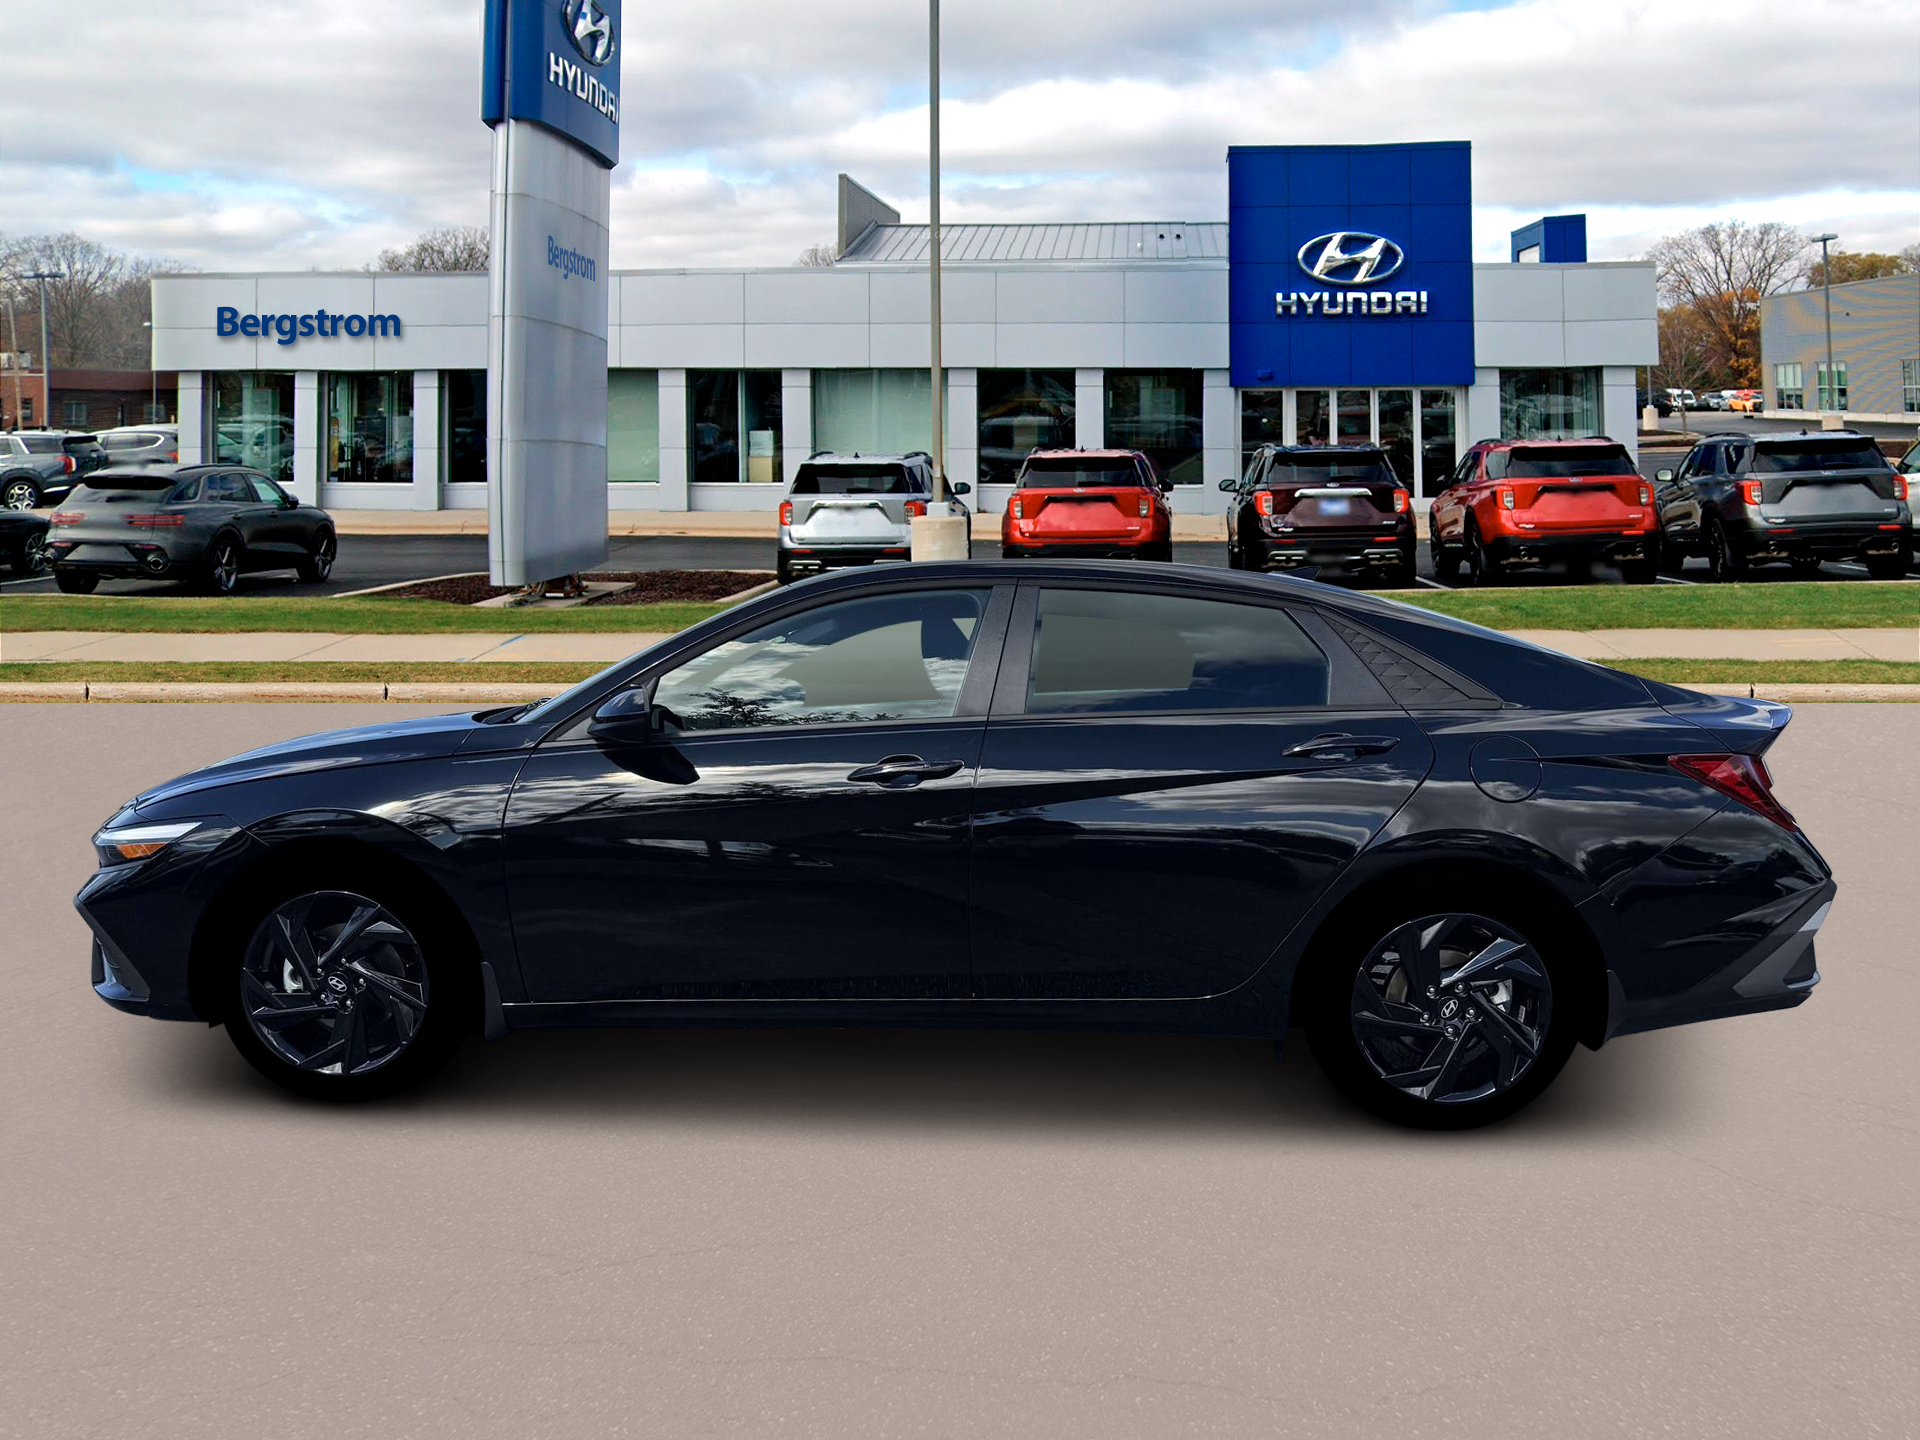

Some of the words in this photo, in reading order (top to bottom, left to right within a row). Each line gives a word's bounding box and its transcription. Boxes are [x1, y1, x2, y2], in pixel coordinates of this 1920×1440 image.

[548, 52, 618, 124] HYUNDAI
[547, 235, 596, 282] Bergstrom
[1275, 291, 1428, 315] HYUNDAI
[216, 306, 401, 346] Bergstrom
